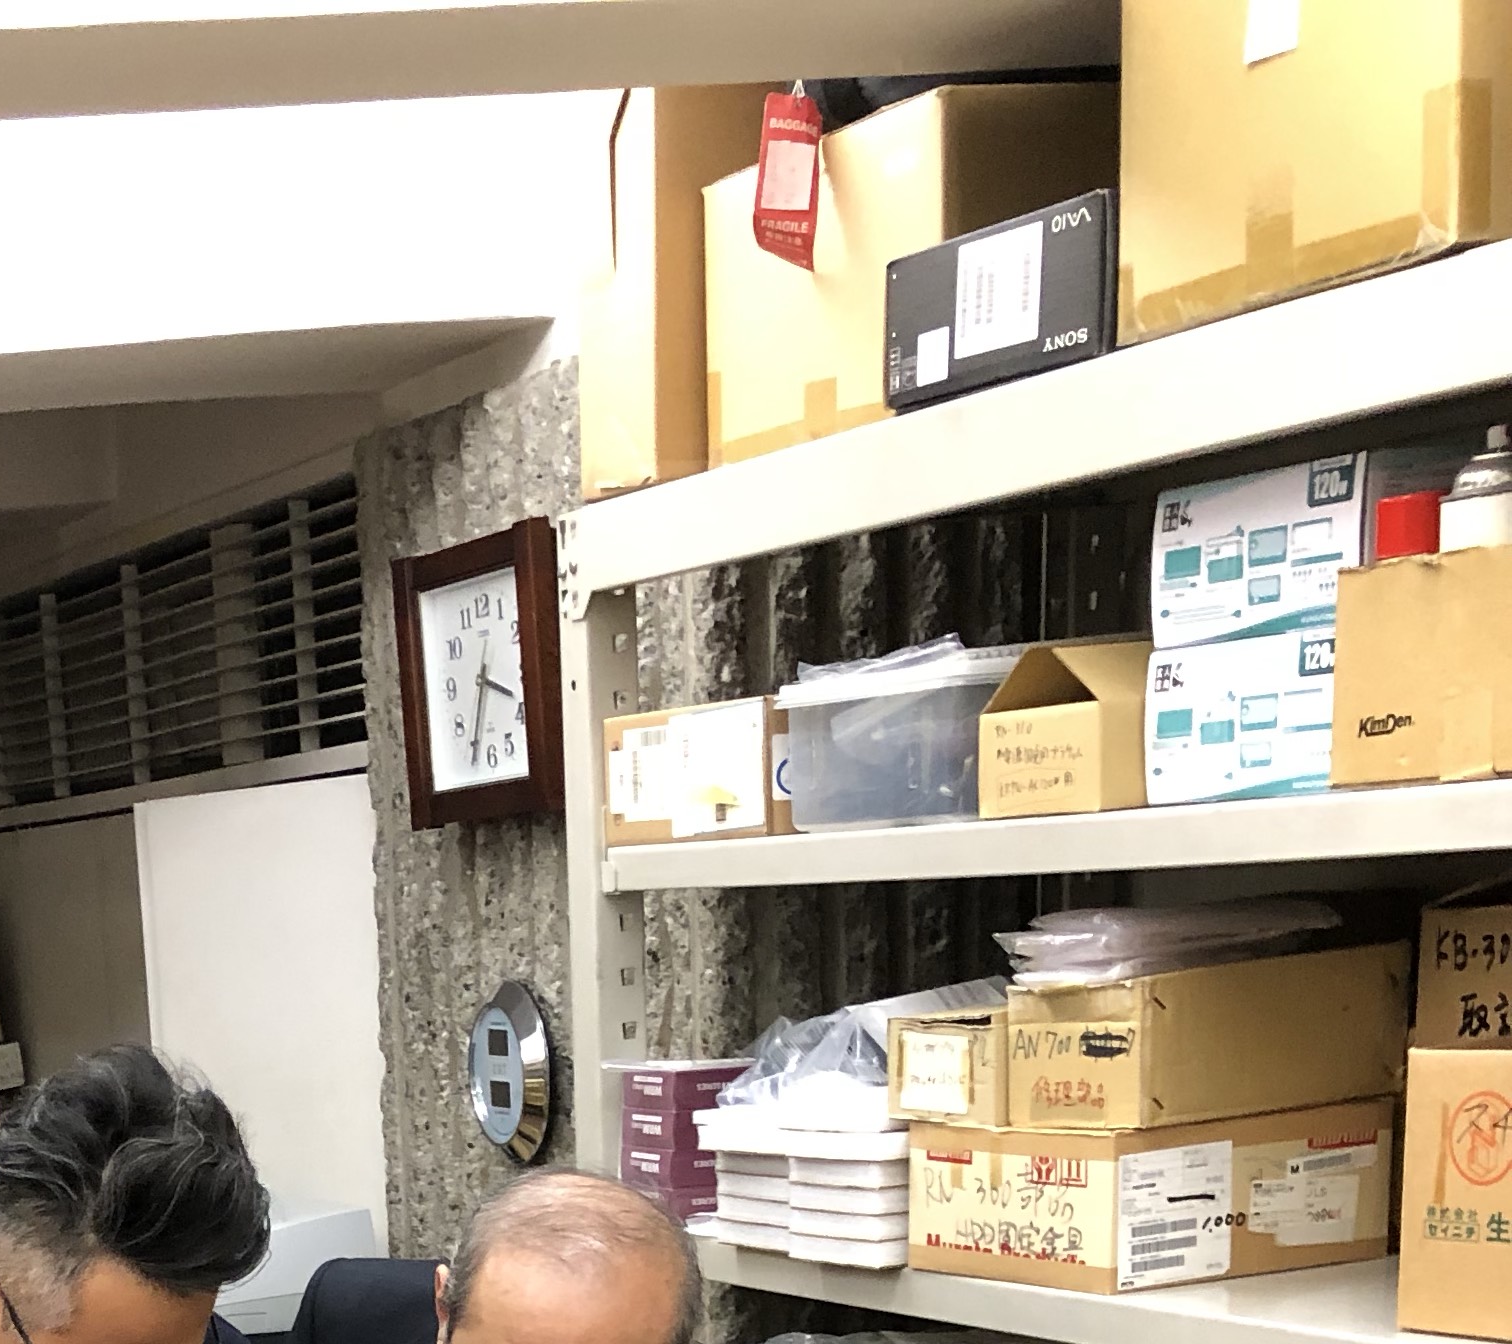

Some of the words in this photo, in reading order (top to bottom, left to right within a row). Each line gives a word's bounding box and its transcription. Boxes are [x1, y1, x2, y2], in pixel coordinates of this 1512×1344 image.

[769, 117, 819, 138] BAGGAGE
[761, 218, 810, 234] FRAGILE
[1051, 206, 1092, 233] VAIO
[1042, 327, 1088, 352] SONY
[475, 593, 490, 618] 12
[496, 598, 504, 620] 1
[460, 607, 471, 630] 11
[510, 620, 520, 645] 2
[446, 636, 463, 660] 10
[446, 677, 457, 702] 9
[515, 702, 525, 725] 4
[454, 714, 465, 738] 8
[486, 744, 498, 768] 6
[504, 732, 515, 757] 5
[1013, 1029, 1041, 1060] AN
